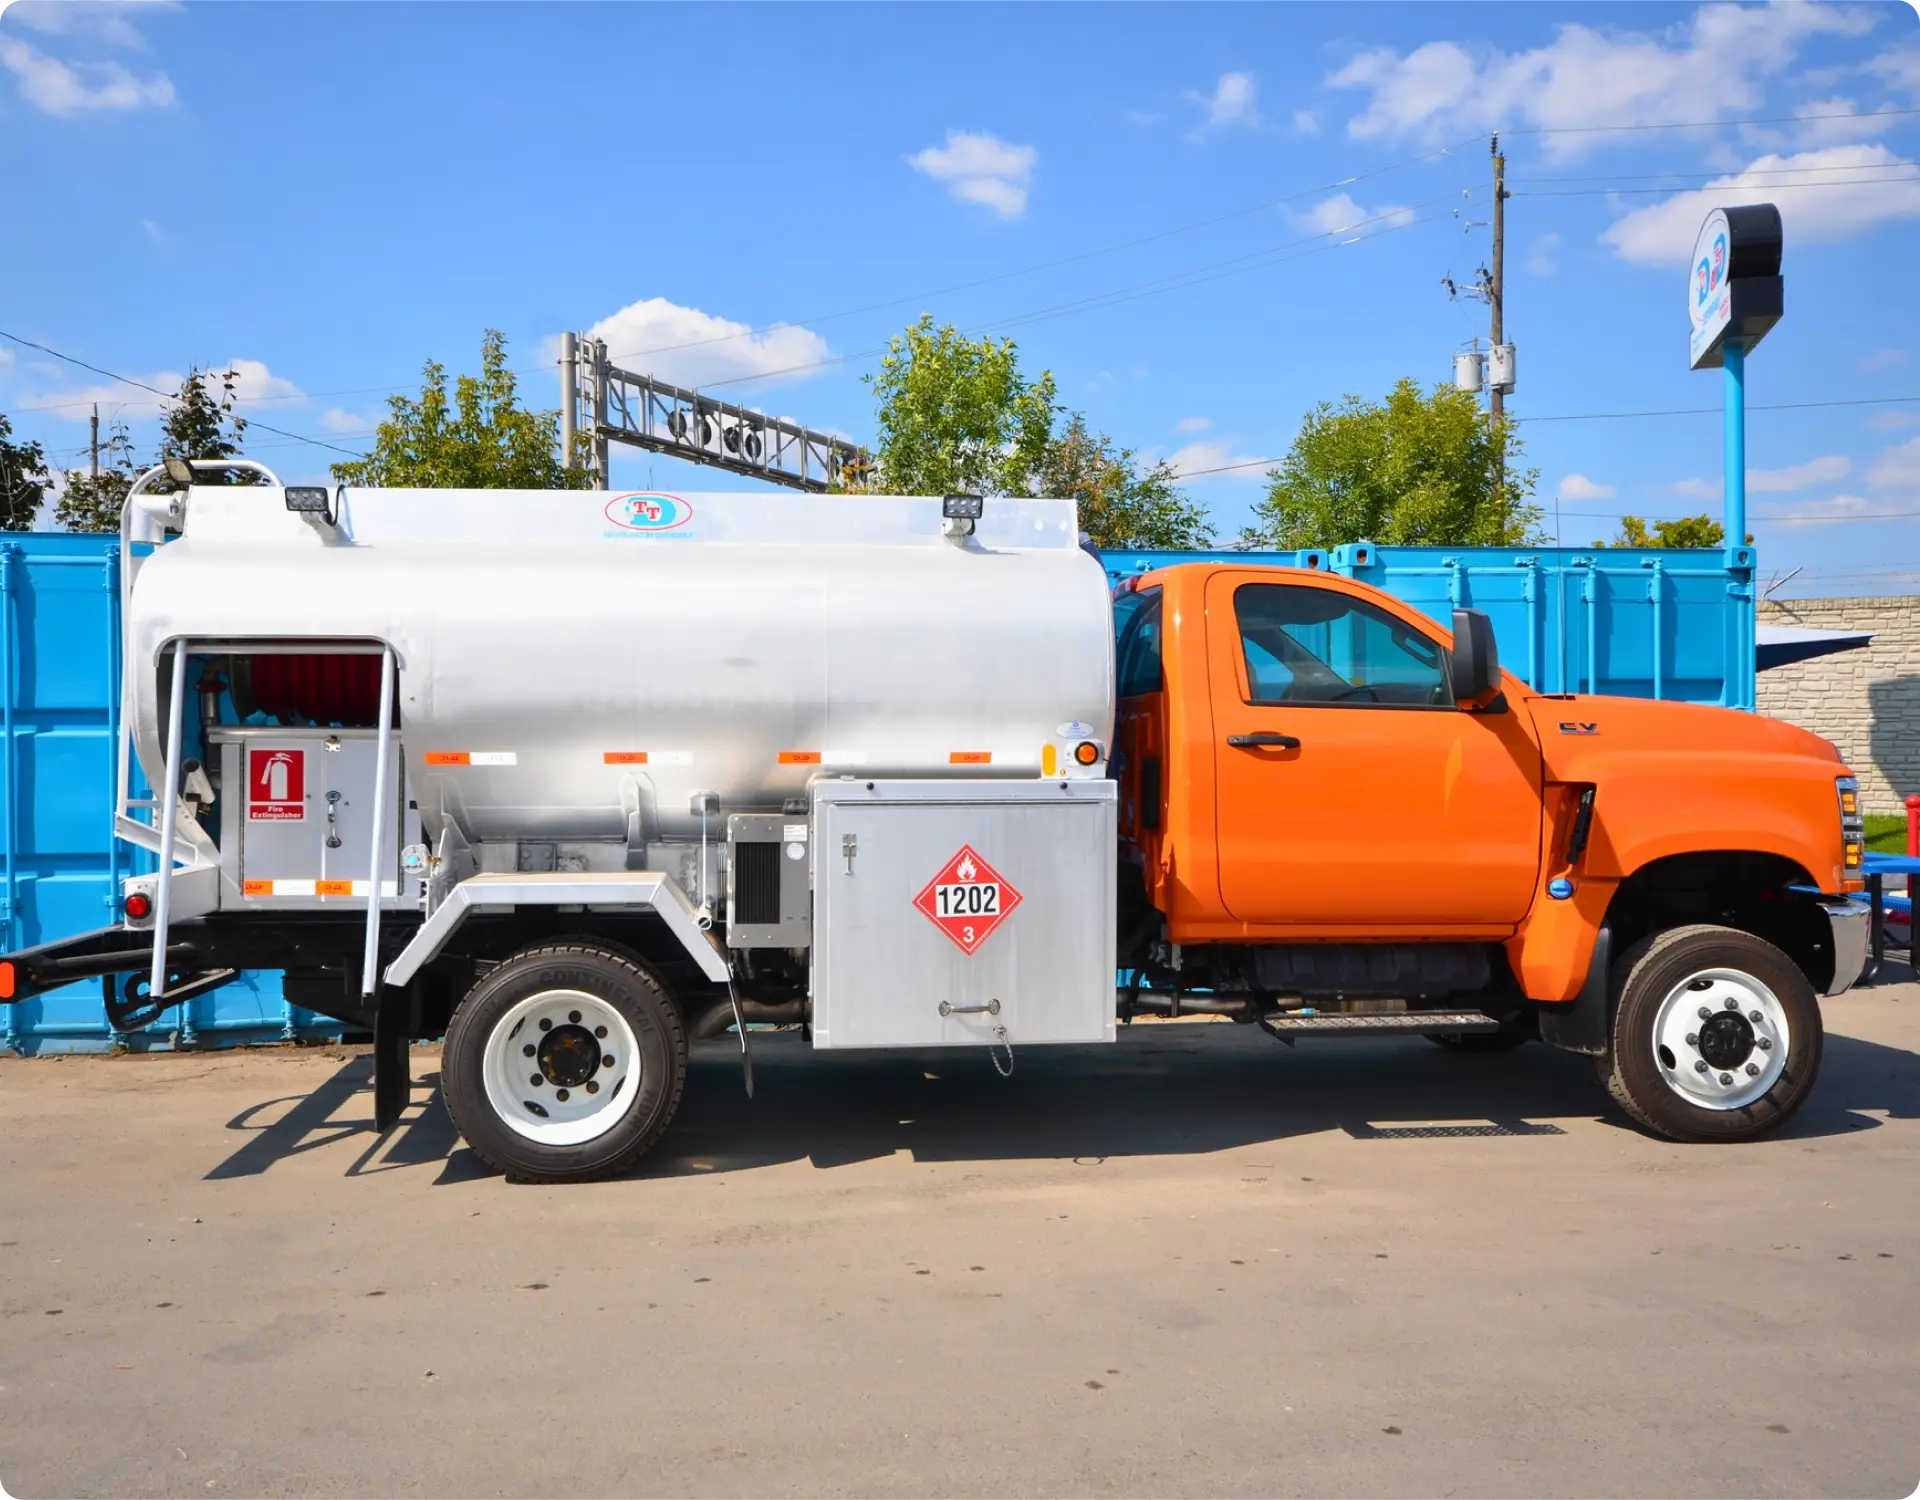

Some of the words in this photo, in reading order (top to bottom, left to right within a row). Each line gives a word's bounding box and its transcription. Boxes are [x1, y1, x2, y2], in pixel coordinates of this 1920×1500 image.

[252, 812, 302, 820] Extinguisher
[938, 885, 997, 915] 1202
[963, 926, 975, 944] 3
